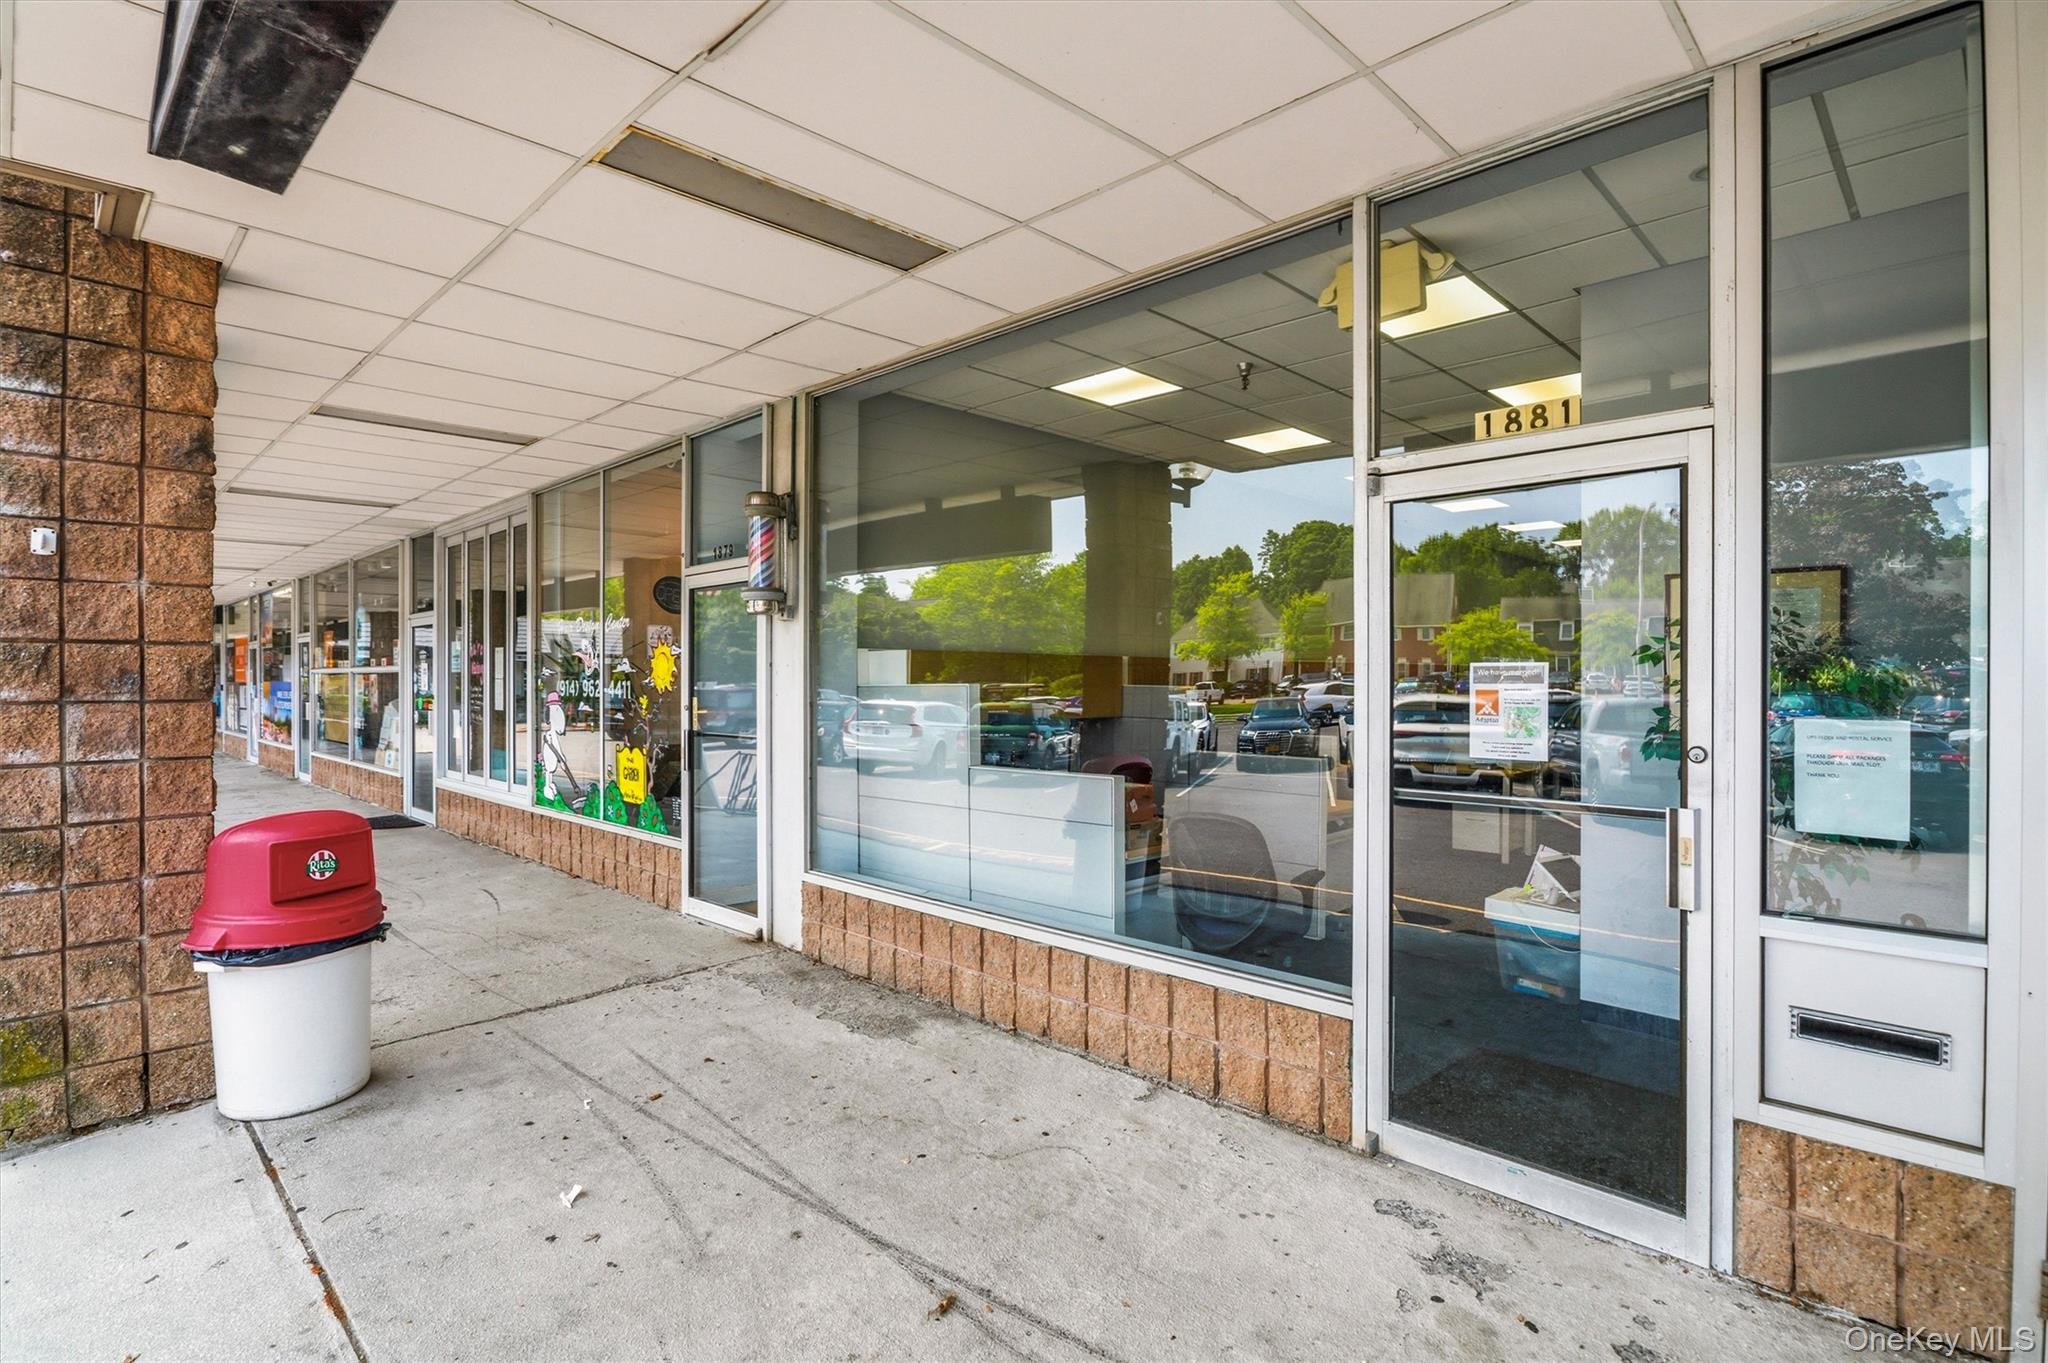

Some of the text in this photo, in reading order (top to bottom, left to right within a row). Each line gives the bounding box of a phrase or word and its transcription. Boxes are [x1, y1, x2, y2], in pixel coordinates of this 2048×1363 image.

[1483, 398, 1570, 438] 1881
[557, 680, 631, 699] (914) 962-4411
